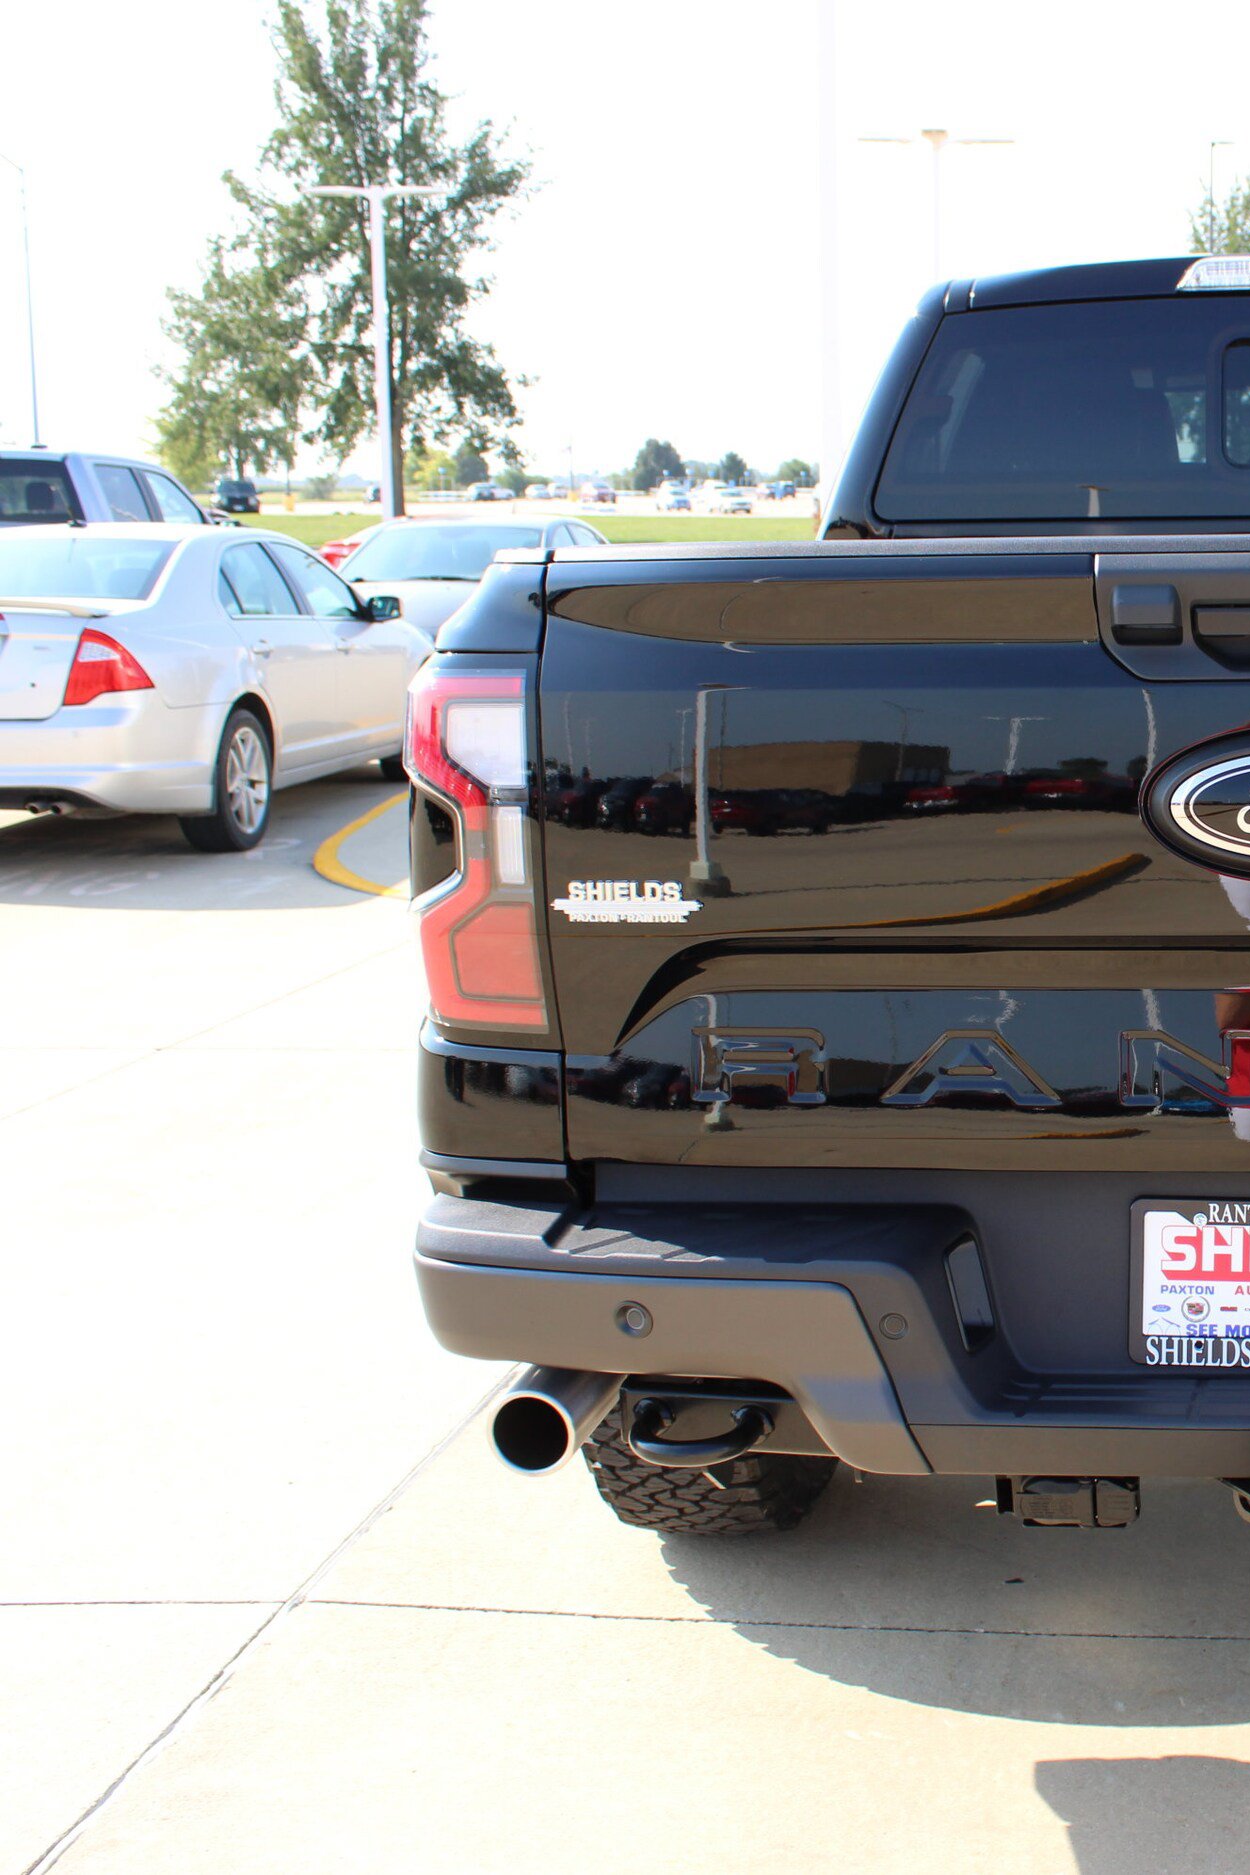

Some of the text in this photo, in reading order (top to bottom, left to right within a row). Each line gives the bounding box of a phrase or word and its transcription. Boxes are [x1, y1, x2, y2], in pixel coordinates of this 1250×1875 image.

[568, 880, 682, 901] SHIELDS
[1160, 1284, 1215, 1296] PAXTON
[1186, 1324, 1218, 1338] SEE
